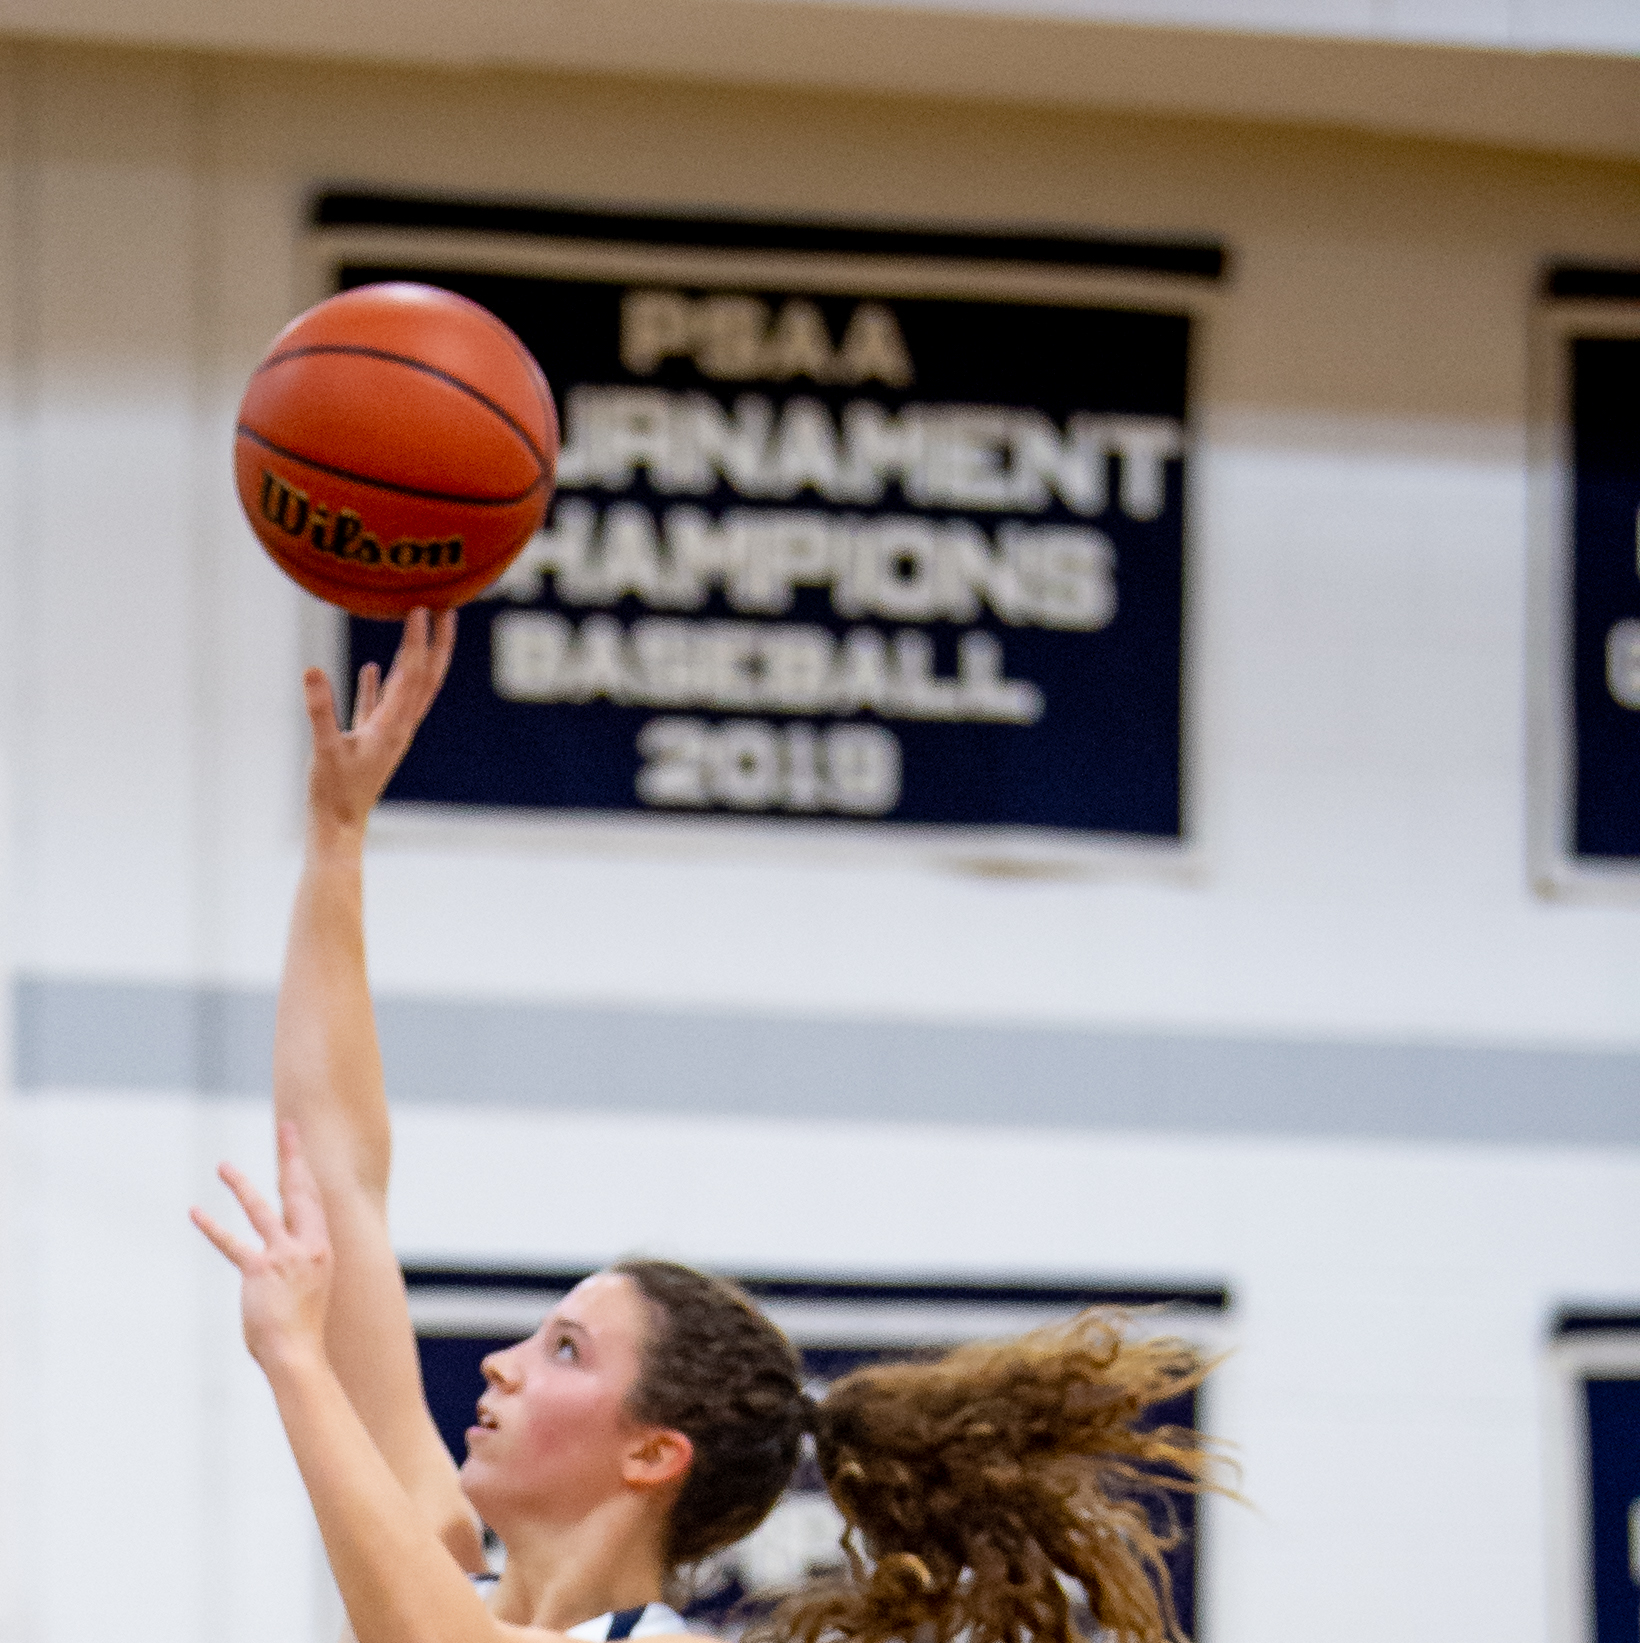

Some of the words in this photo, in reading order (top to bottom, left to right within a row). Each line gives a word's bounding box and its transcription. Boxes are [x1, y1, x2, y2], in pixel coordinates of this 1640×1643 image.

[619, 290, 913, 387] PSAA
[557, 383, 1182, 520] URNAMENT
[259, 467, 465, 574] Wilson
[482, 496, 1118, 631] HAMPIONS
[491, 610, 1044, 726] BASEBALL
[634, 718, 904, 816] 2019
